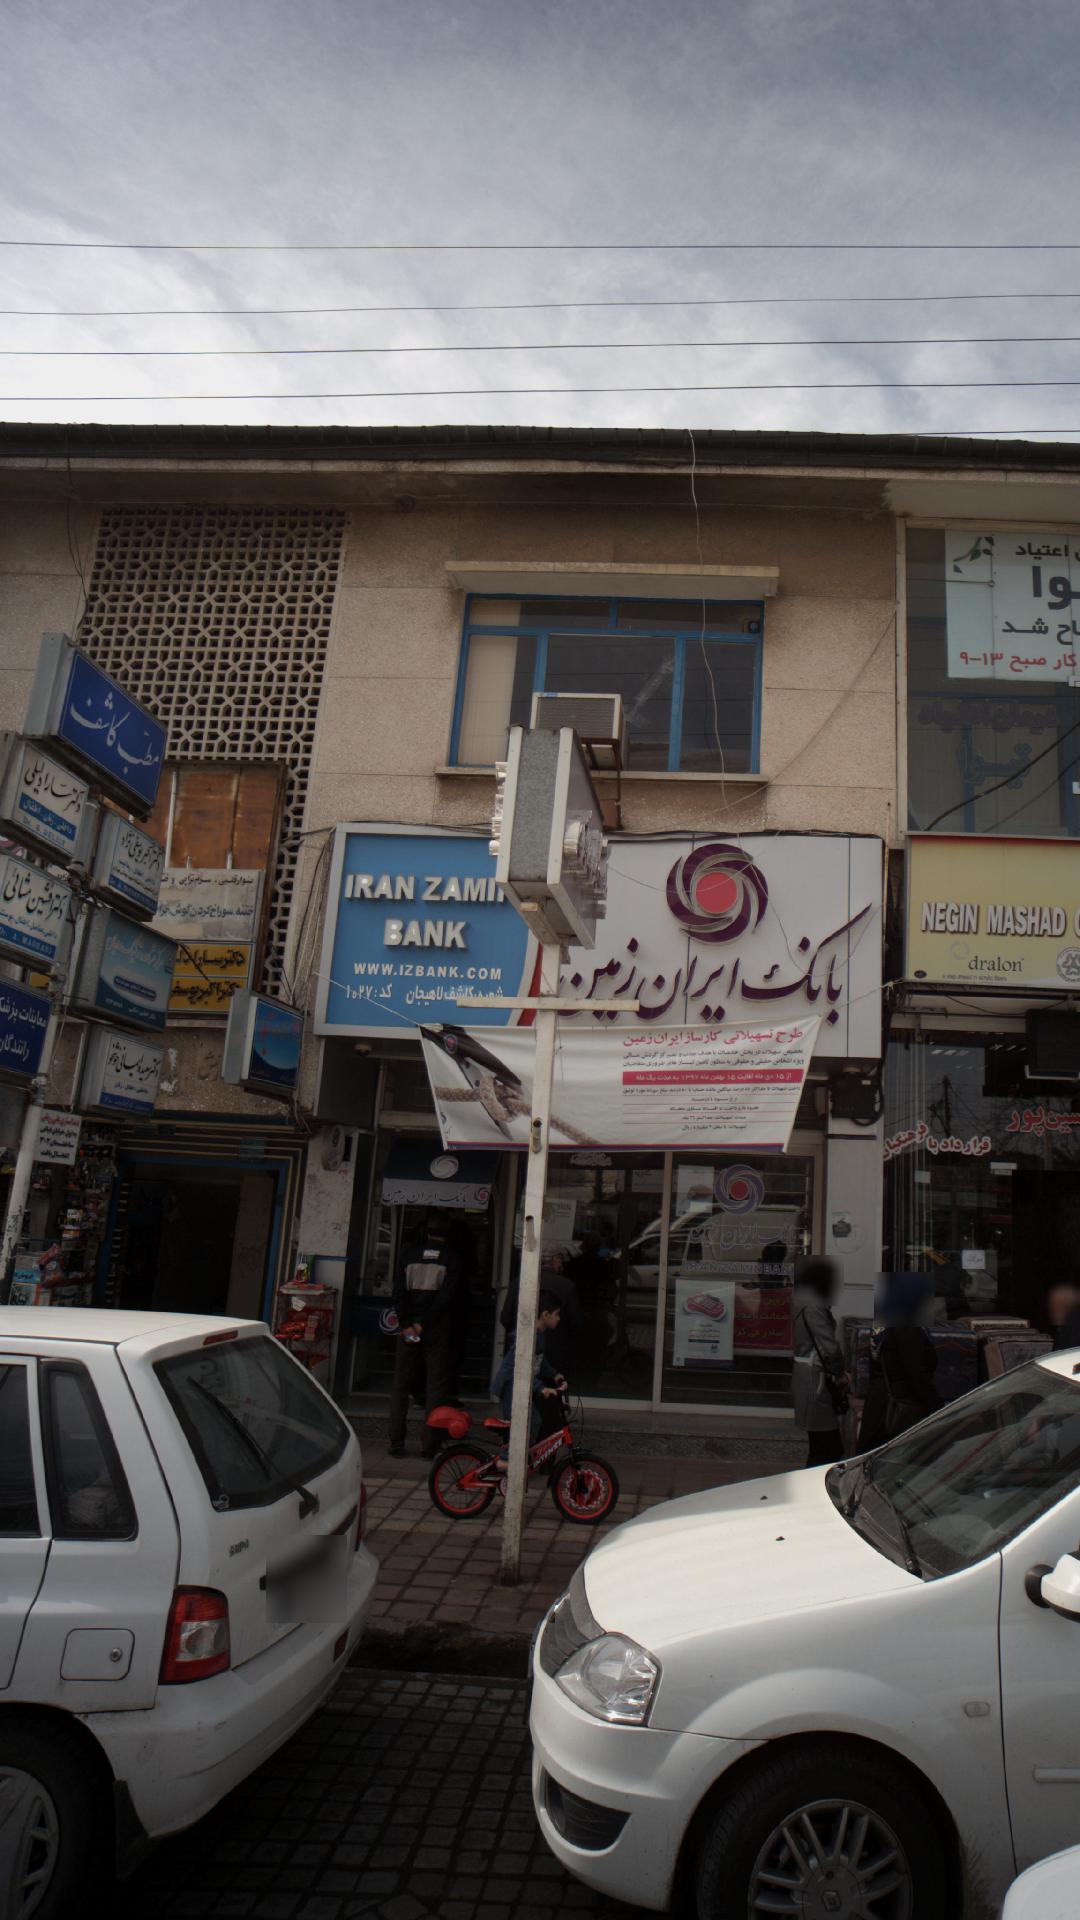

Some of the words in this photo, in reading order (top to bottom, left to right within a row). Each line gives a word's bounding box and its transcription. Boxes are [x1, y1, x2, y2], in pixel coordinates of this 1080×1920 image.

[1015, 542, 1068, 560] اعتیاد
[1002, 617, 1048, 634] شد
[1009, 655, 1047, 672] صبح
[70, 692, 130, 747] کاشف
[344, 874, 416, 901] IRAN
[921, 901, 980, 934] NEGIN
[986, 904, 1067, 938] MASHAD
[384, 918, 467, 948] BANK
[353, 962, 502, 980] WWW.IZBANK.COM
[741, 903, 872, 1025] بانک
[968, 955, 1023, 972] dralon
[559, 937, 637, 1020] زمین
[405, 984, 444, 1006] لاهیجان
[445, 984, 475, 1000] کاشف
[635, 955, 741, 1022] ایران
[623, 1032, 653, 1047] زمین
[654, 1031, 683, 1046] ایران
[684, 1030, 722, 1045] کارساز
[724, 1029, 773, 1045] تسهیلاتی
[776, 1027, 803, 1043] طرح
[1005, 1104, 1045, 1137] پور
[1044, 1110, 1080, 1134] سین
[926, 1136, 939, 1155] با
[939, 1136, 992, 1156] قرارداد
[407, 1191, 438, 1204] ایران
